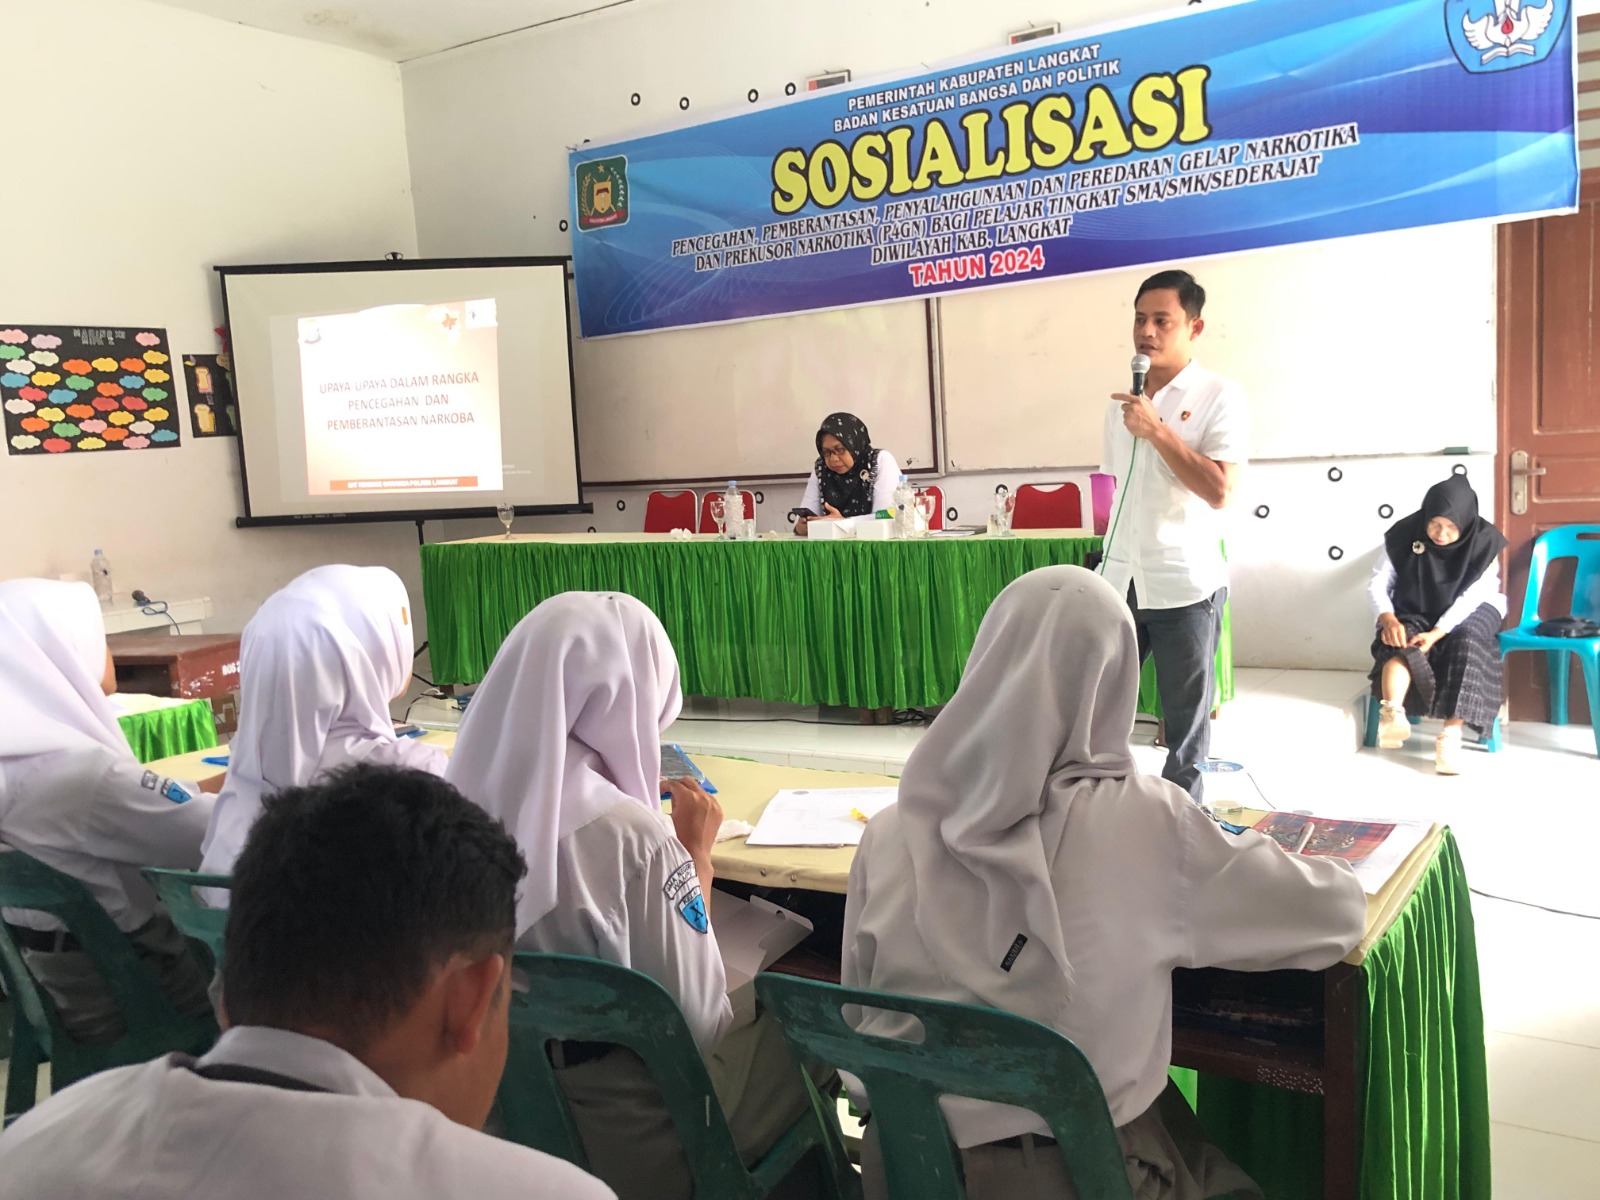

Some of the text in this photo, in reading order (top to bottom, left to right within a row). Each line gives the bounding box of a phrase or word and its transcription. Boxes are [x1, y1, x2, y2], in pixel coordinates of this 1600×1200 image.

[834, 60, 1120, 133] BADAN KESATUAN BANGSA DAN POLITIK
[848, 44, 1100, 111] PEMERINTAH KABUPATEN LANGKAT
[772, 64, 1210, 214] SOSIALISASI
[672, 122, 1360, 257] PENCEGAHAN, PEMBERANTASAN, PENYALAHGUNAAN DAN PEREDARAN GELAP NARKOTIKA
[695, 155, 1321, 272] DAN PREKUSOR NARKOTIKA (P4GN) BAGI PELAJAR TINGKAT SMA/SMK/SEDERAJAT
[871, 217, 1072, 265] DIWILAYAH KAB. LANGKAT
[909, 245, 1045, 287] TAHUN 2024
[348, 394, 449, 411] PENCEGAHAN DAN
[390, 375, 428, 388] DALAM
[432, 371, 479, 386] RANGKA
[327, 412, 475, 430] PEMBERANTASAN NARKOBA
[690, 902, 704, 922] X
